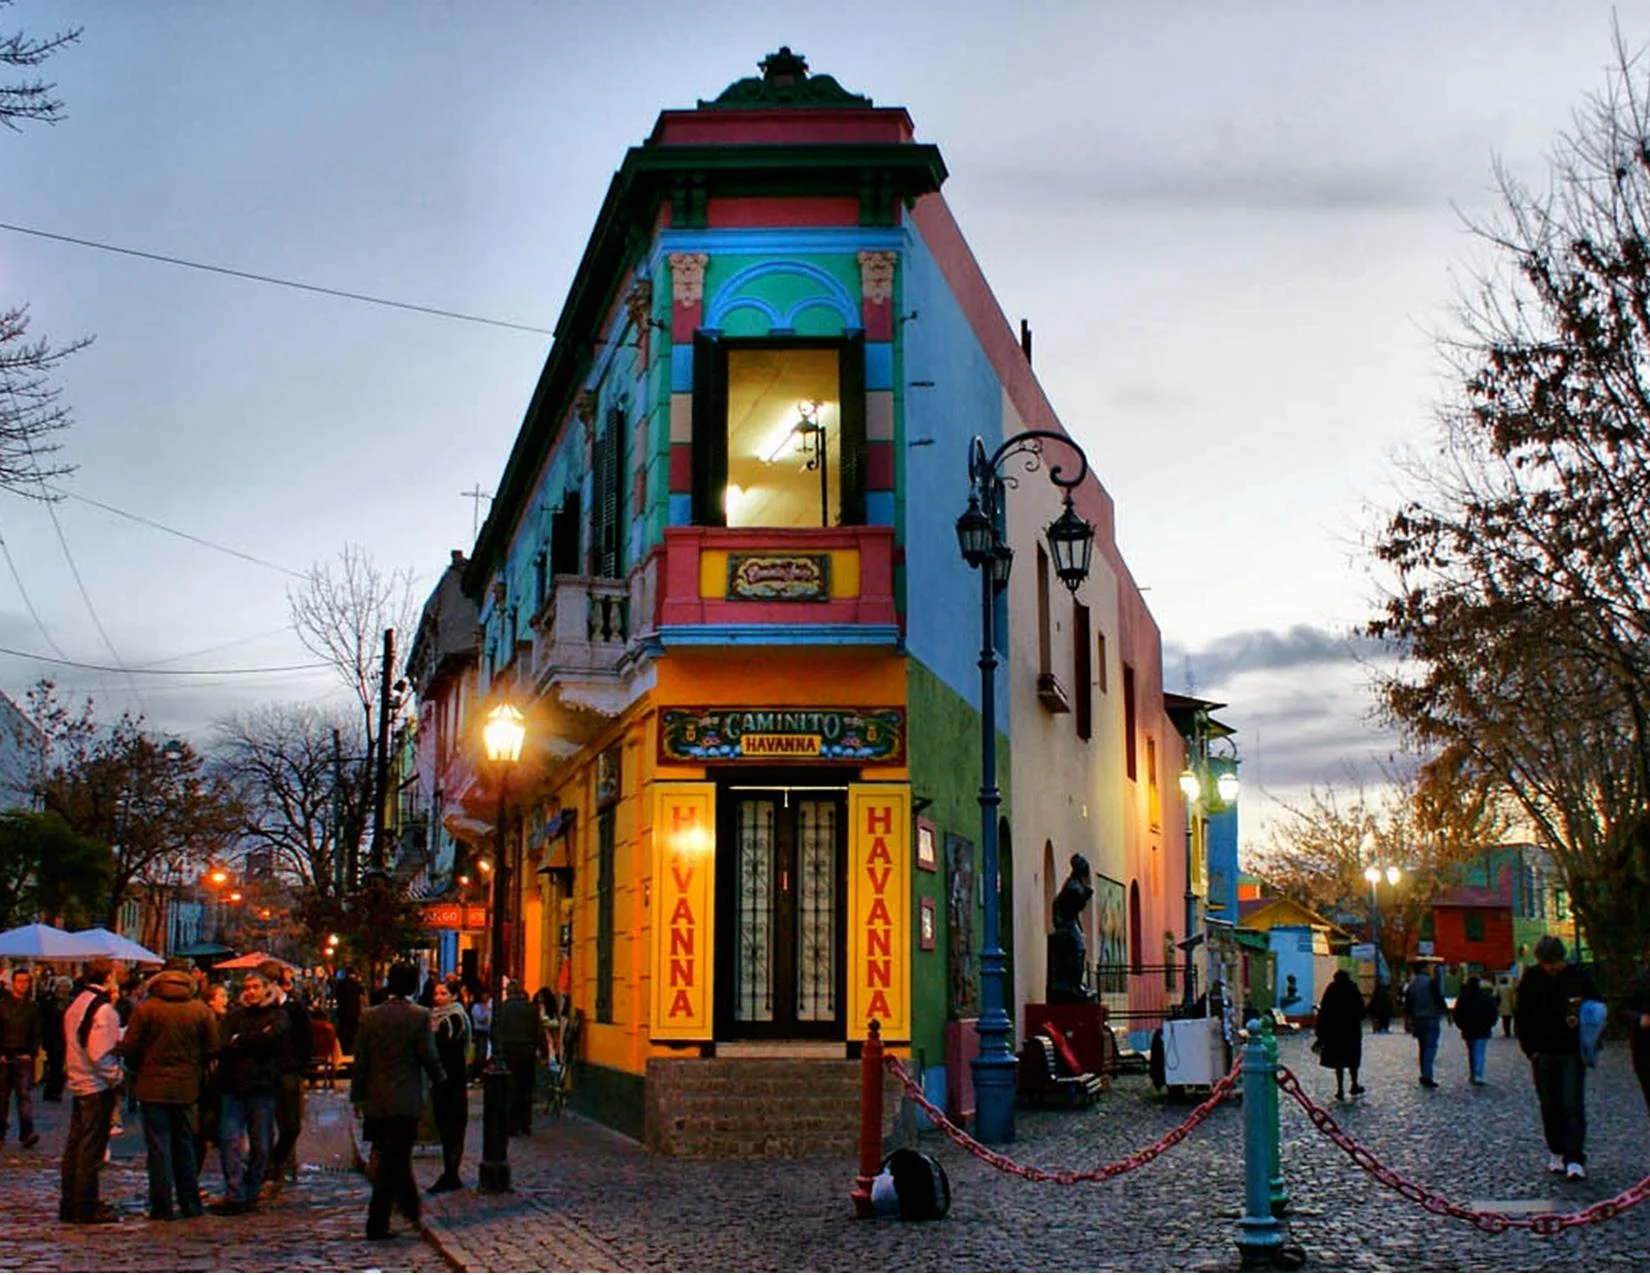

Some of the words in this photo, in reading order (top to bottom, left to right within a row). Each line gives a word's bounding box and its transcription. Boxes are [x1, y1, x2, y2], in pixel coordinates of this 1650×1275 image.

[726, 712, 840, 739] CAMINITO
[745, 737, 817, 752] HAVANNA
[668, 806, 697, 1018] HVANNA
[866, 806, 893, 1019] HAVANNA
